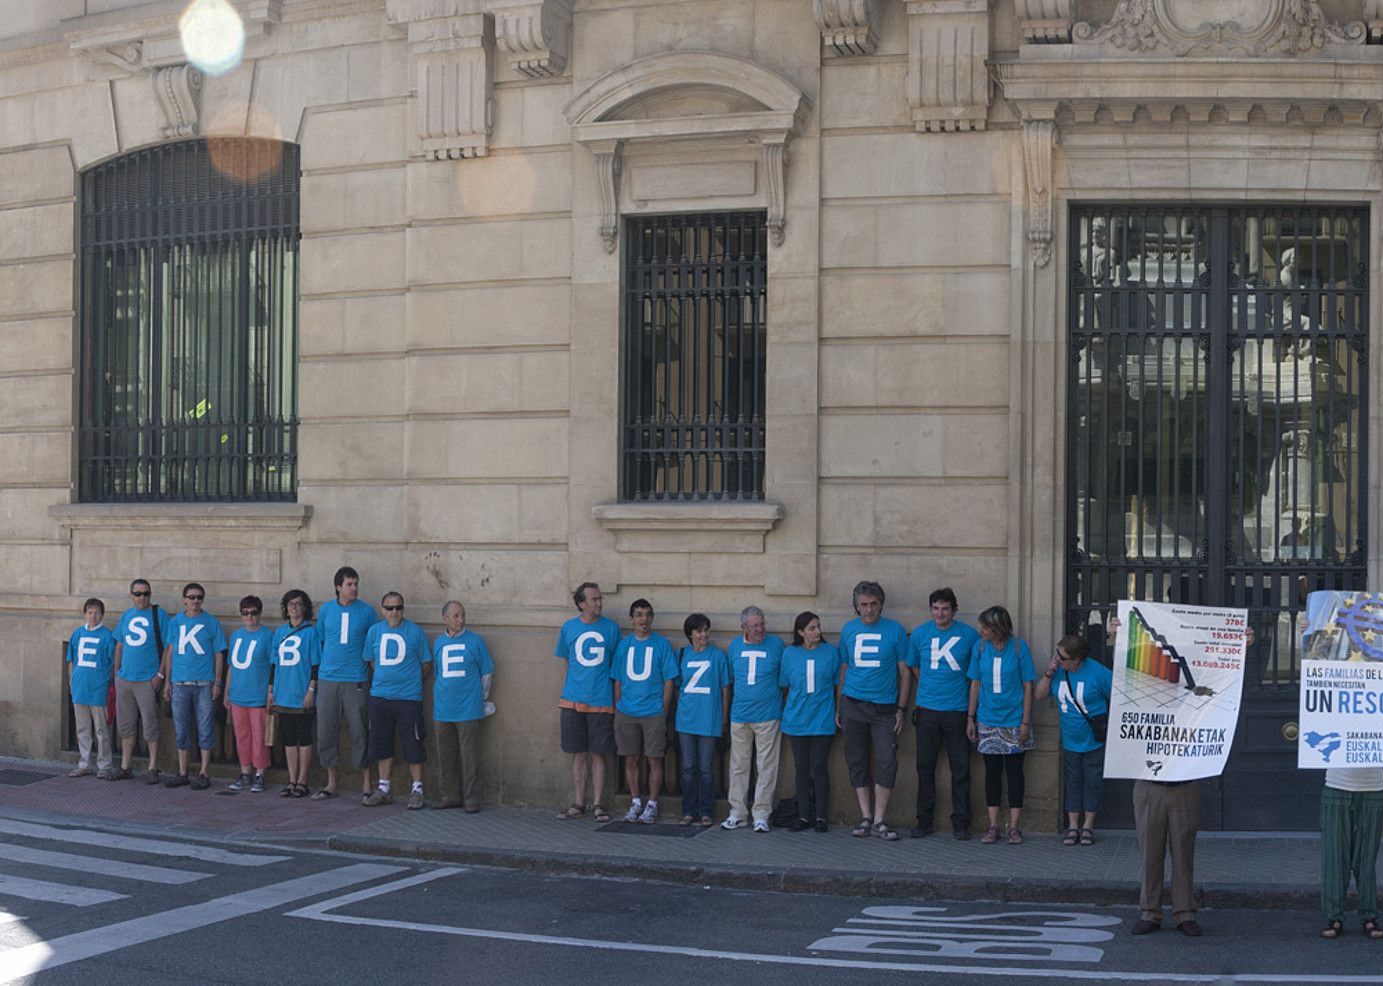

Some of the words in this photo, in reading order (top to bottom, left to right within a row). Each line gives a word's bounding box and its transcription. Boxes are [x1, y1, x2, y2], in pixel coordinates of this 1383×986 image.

[126, 617, 148, 646] S
[178, 624, 204, 654] K
[340, 613, 349, 644] I
[77, 637, 100, 667] E
[231, 638, 257, 670] U
[279, 636, 301, 666] B
[380, 633, 405, 665] D
[442, 644, 465, 677] E
[575, 631, 604, 666] G
[627, 647, 653, 681] U
[854, 634, 881, 667] E
[931, 637, 960, 670] K
[684, 661, 710, 694] Z
[741, 651, 766, 685] T
[807, 660, 814, 693] I
[993, 657, 1001, 693] I
[1306, 667, 1323, 678] LAS
[1325, 668, 1364, 680] FAMILIAS
[1366, 669, 1376, 680] DE
[1333, 681, 1366, 689] NECESITAN
[1305, 689, 1332, 713] UN
[1119, 724, 1227, 743] SAKABANAKETAK
[1121, 712, 1139, 724] 650
[1140, 713, 1175, 725] FAMILIA
[1146, 742, 1224, 757] HIPOTEKATURIK
[1346, 740, 1382, 752] EUSKAL
[1346, 752, 1383, 763] EUSKAL
[807, 906, 1122, 962] BUS
